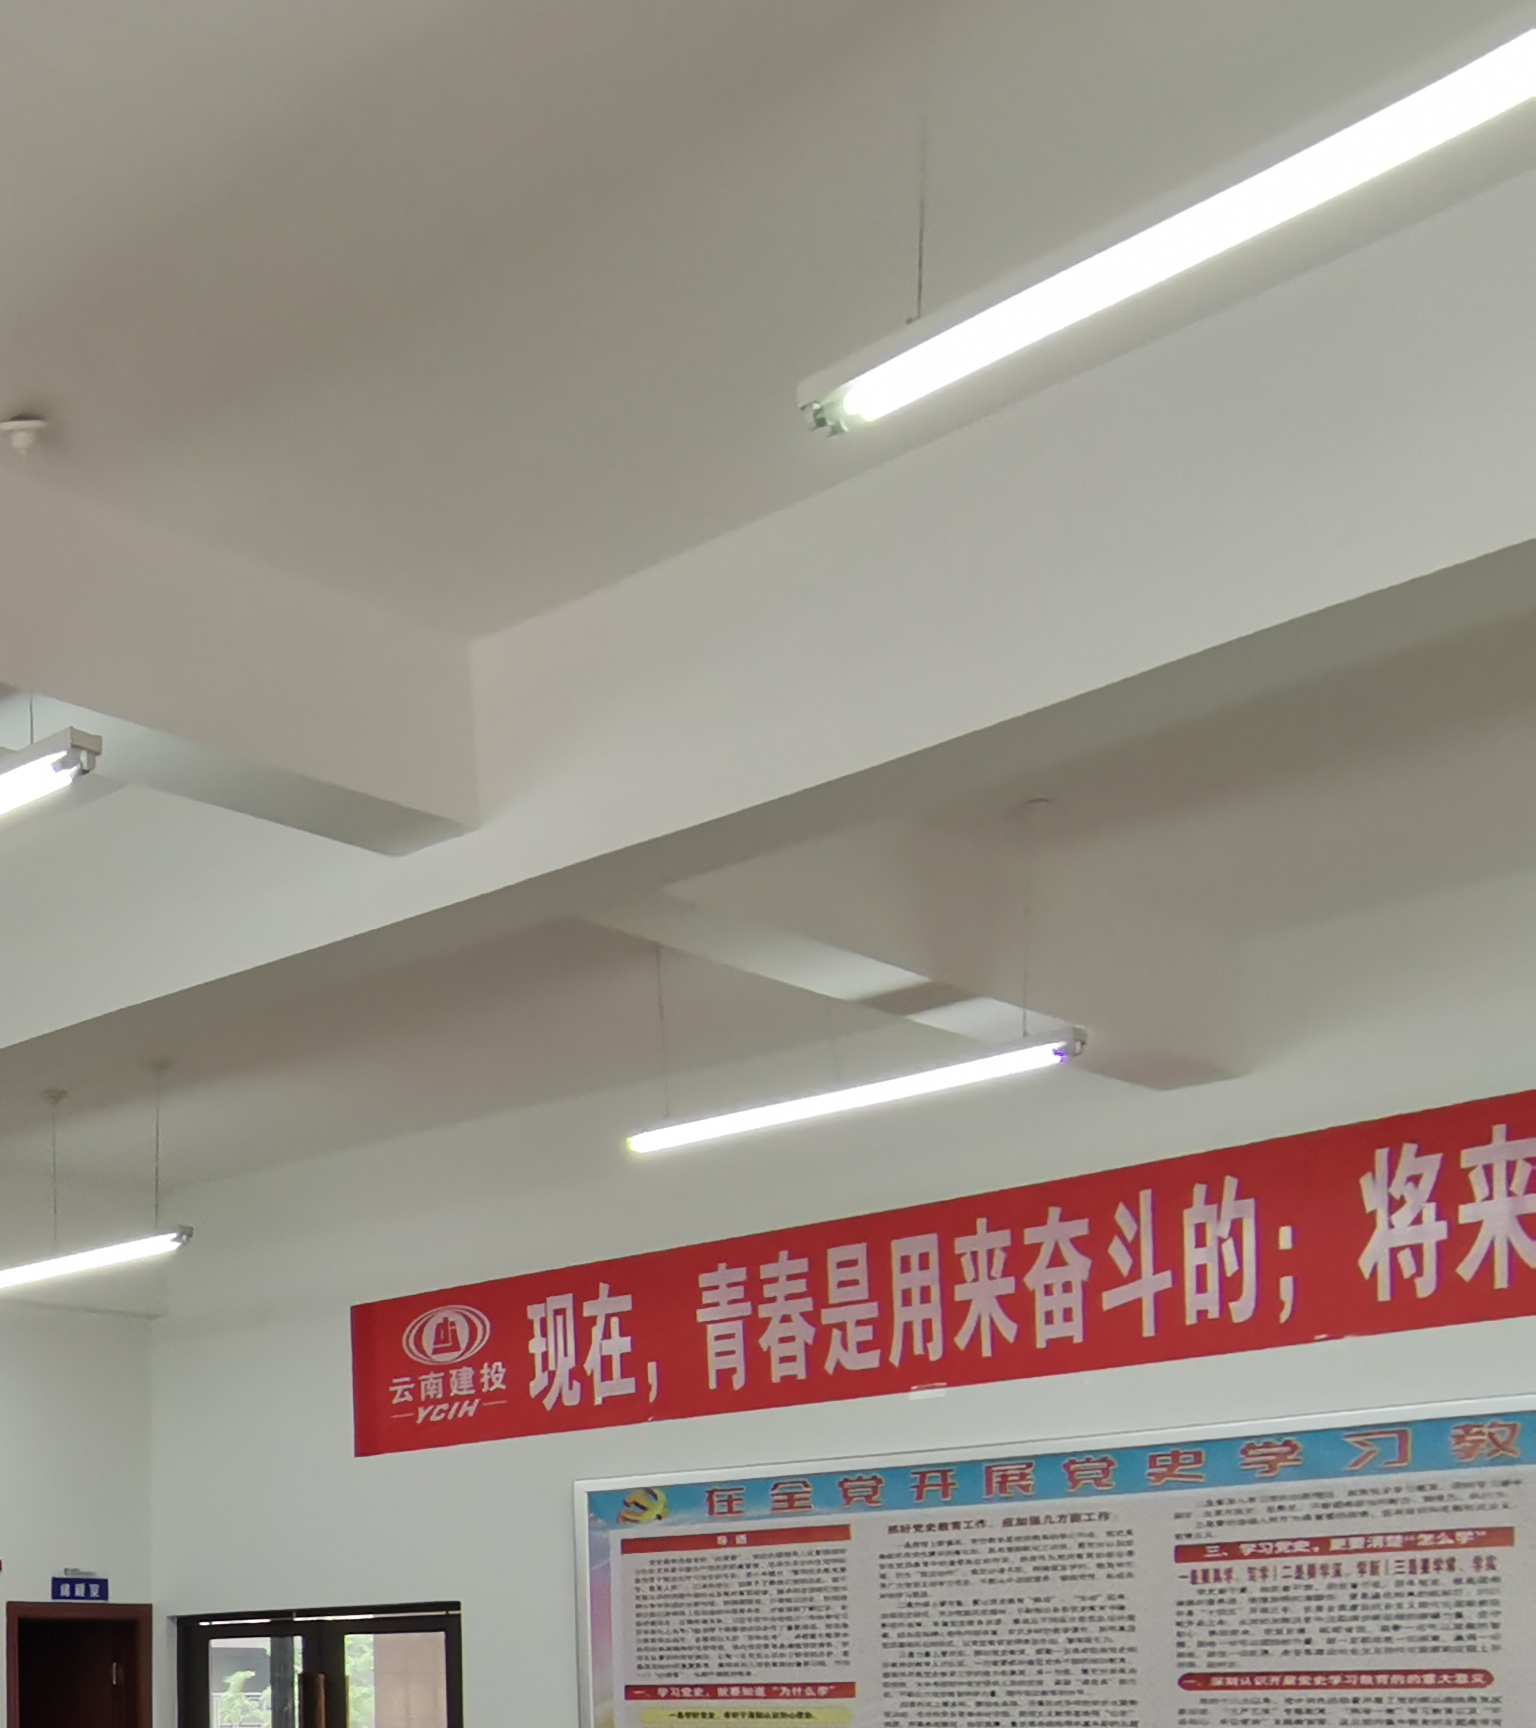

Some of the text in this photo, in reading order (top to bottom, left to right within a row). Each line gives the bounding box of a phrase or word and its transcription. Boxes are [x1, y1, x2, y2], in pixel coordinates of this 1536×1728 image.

[389, 1361, 506, 1405] 云南建投
[416, 1398, 481, 1424] YCIH
